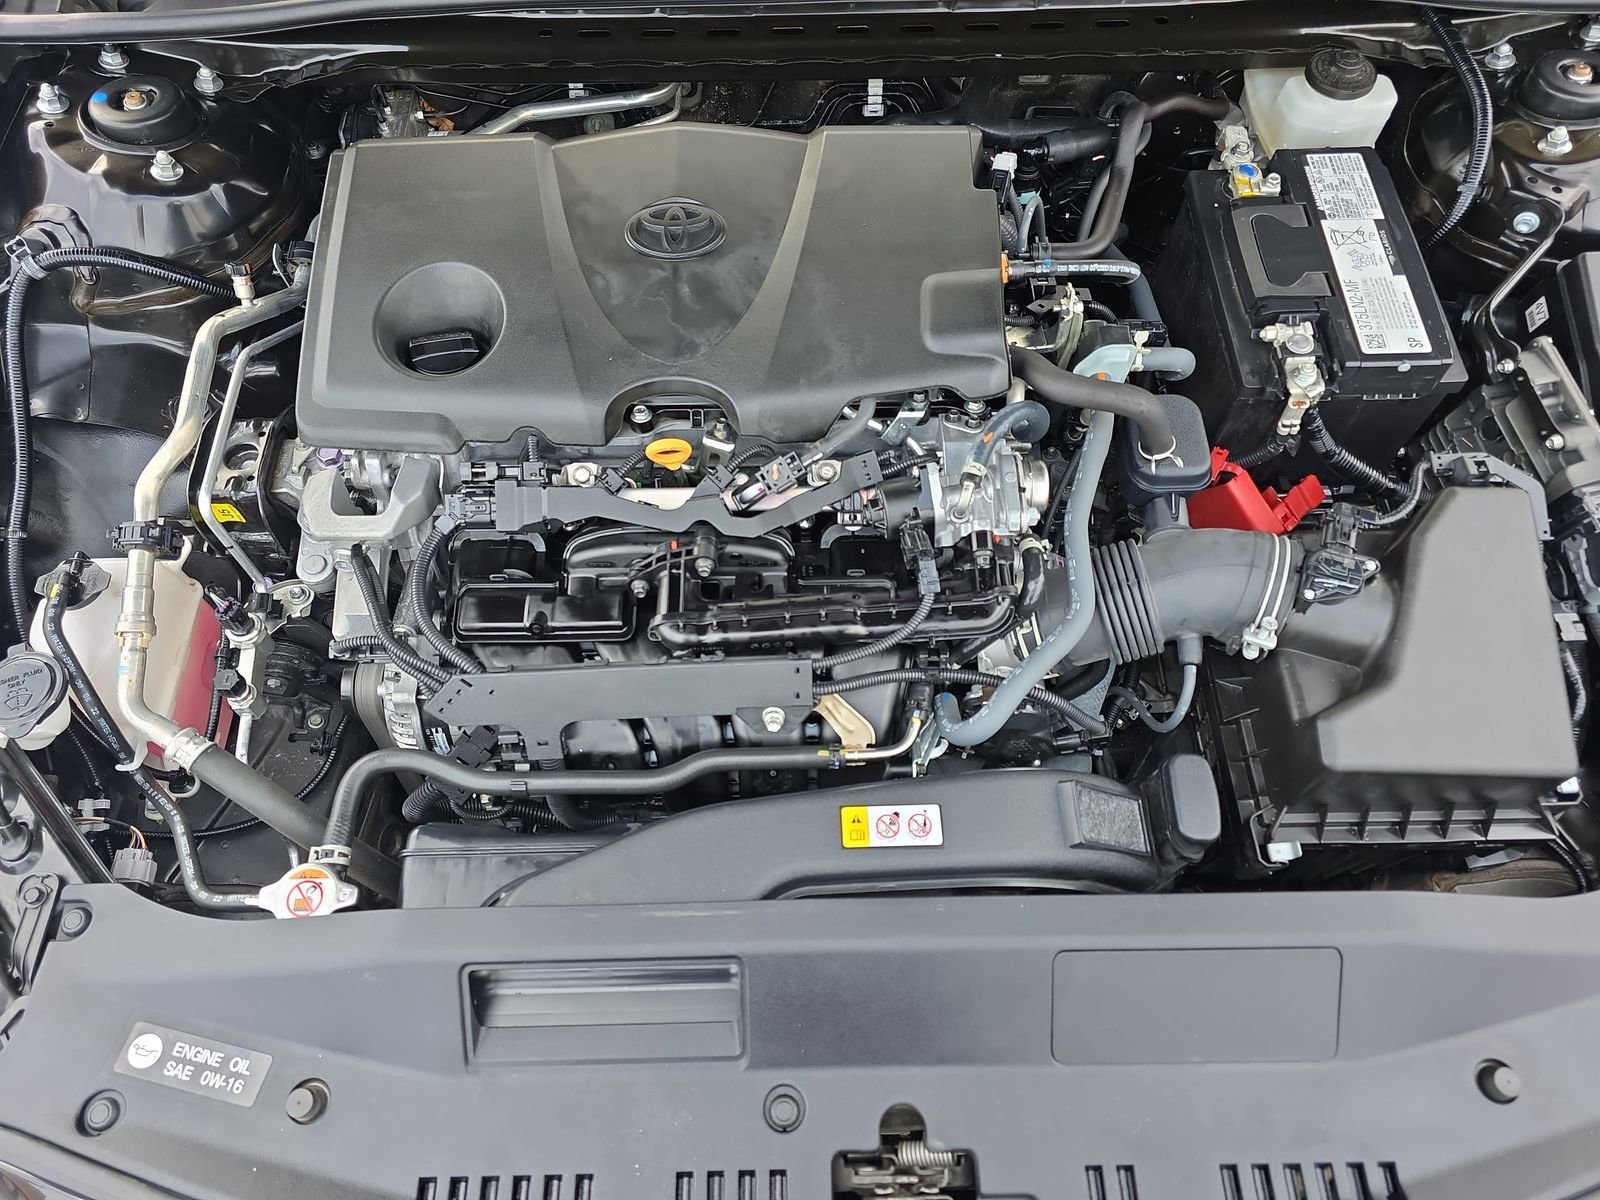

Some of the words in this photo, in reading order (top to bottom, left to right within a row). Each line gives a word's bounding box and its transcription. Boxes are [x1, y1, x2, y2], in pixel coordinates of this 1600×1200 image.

[1343, 278, 1374, 331] 375LN2-MF
[1407, 337, 1424, 349] SP
[51, 633, 66, 656] WATER
[172, 1041, 224, 1067] ENGINE
[229, 1057, 251, 1075] OIL
[163, 1061, 195, 1080] SAE
[200, 1070, 245, 1094] 0W-16
